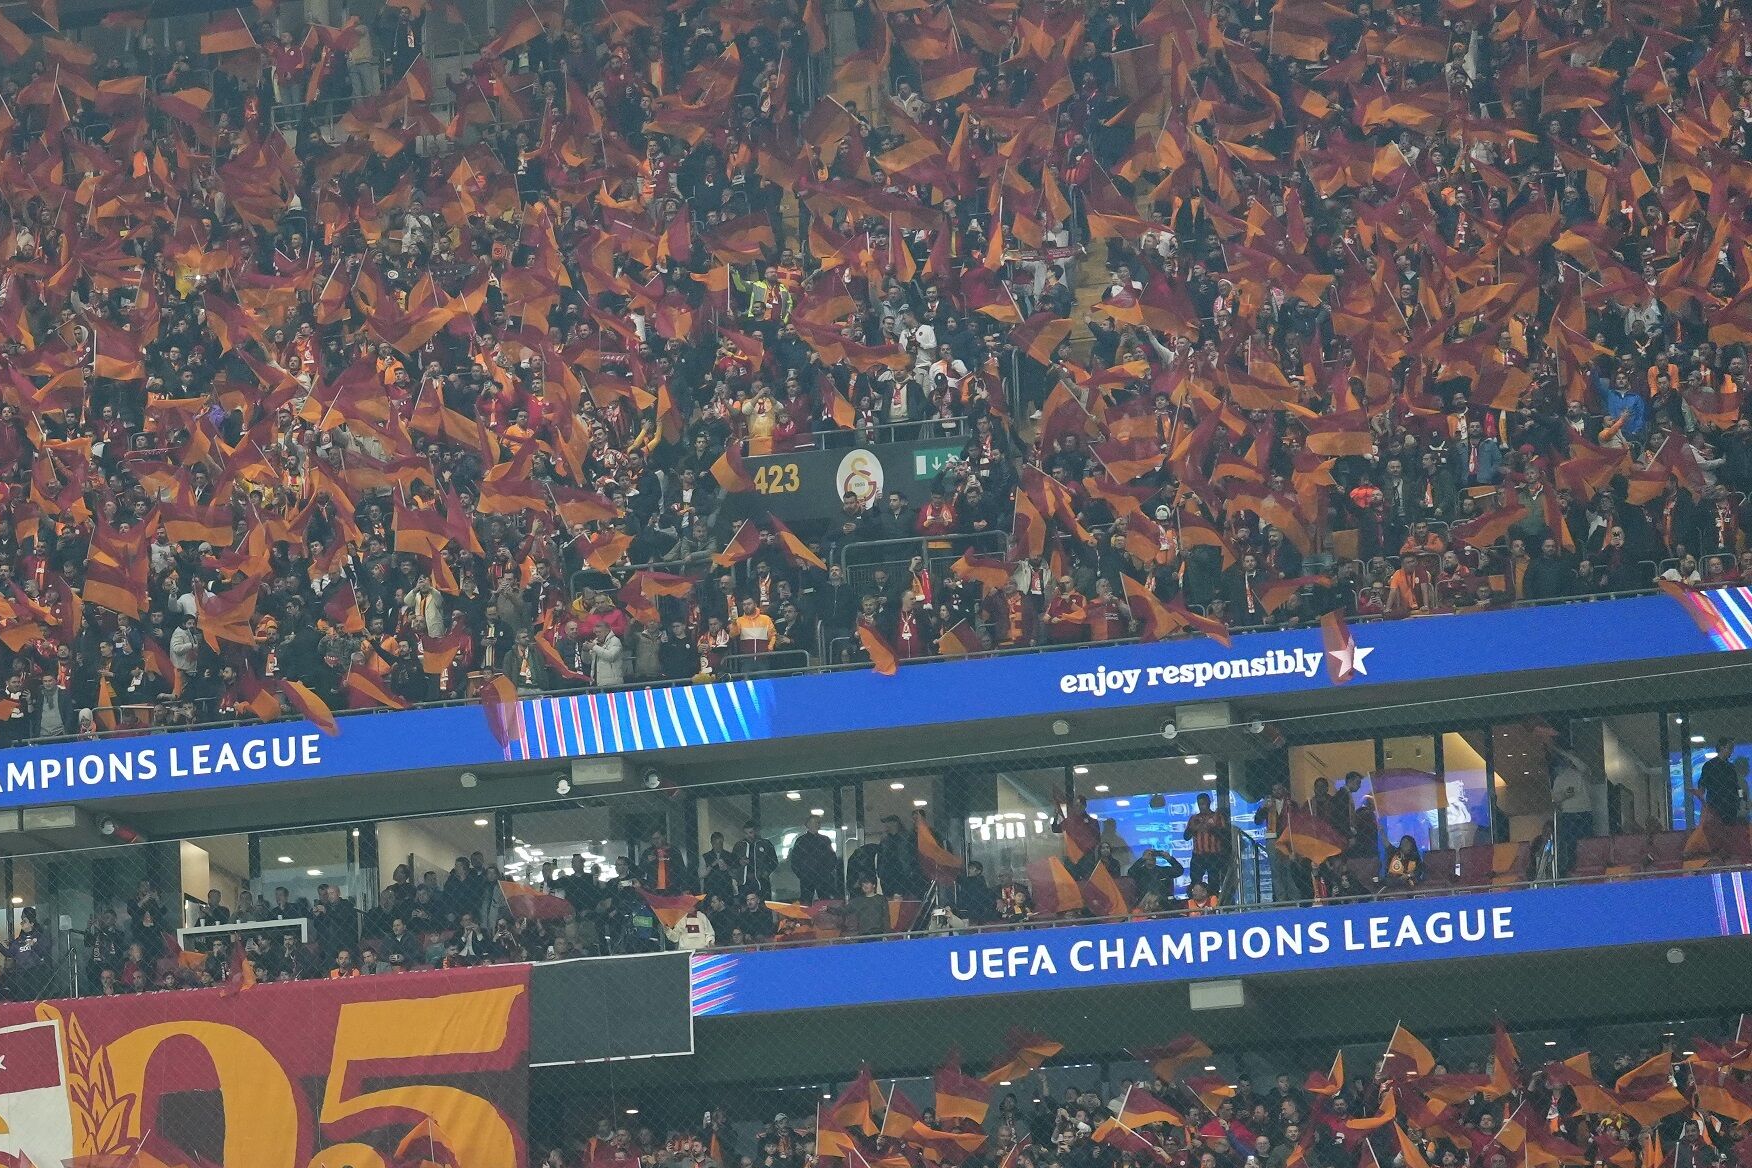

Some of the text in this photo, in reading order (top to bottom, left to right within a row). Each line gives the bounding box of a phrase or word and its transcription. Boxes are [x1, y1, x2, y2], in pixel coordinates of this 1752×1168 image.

[754, 463, 800, 495] 423
[1060, 648, 1324, 697] enjoy responsibly
[169, 733, 322, 777] LEAGUE
[950, 906, 1515, 981] UEFA CHAMPIONS LEAGUE
